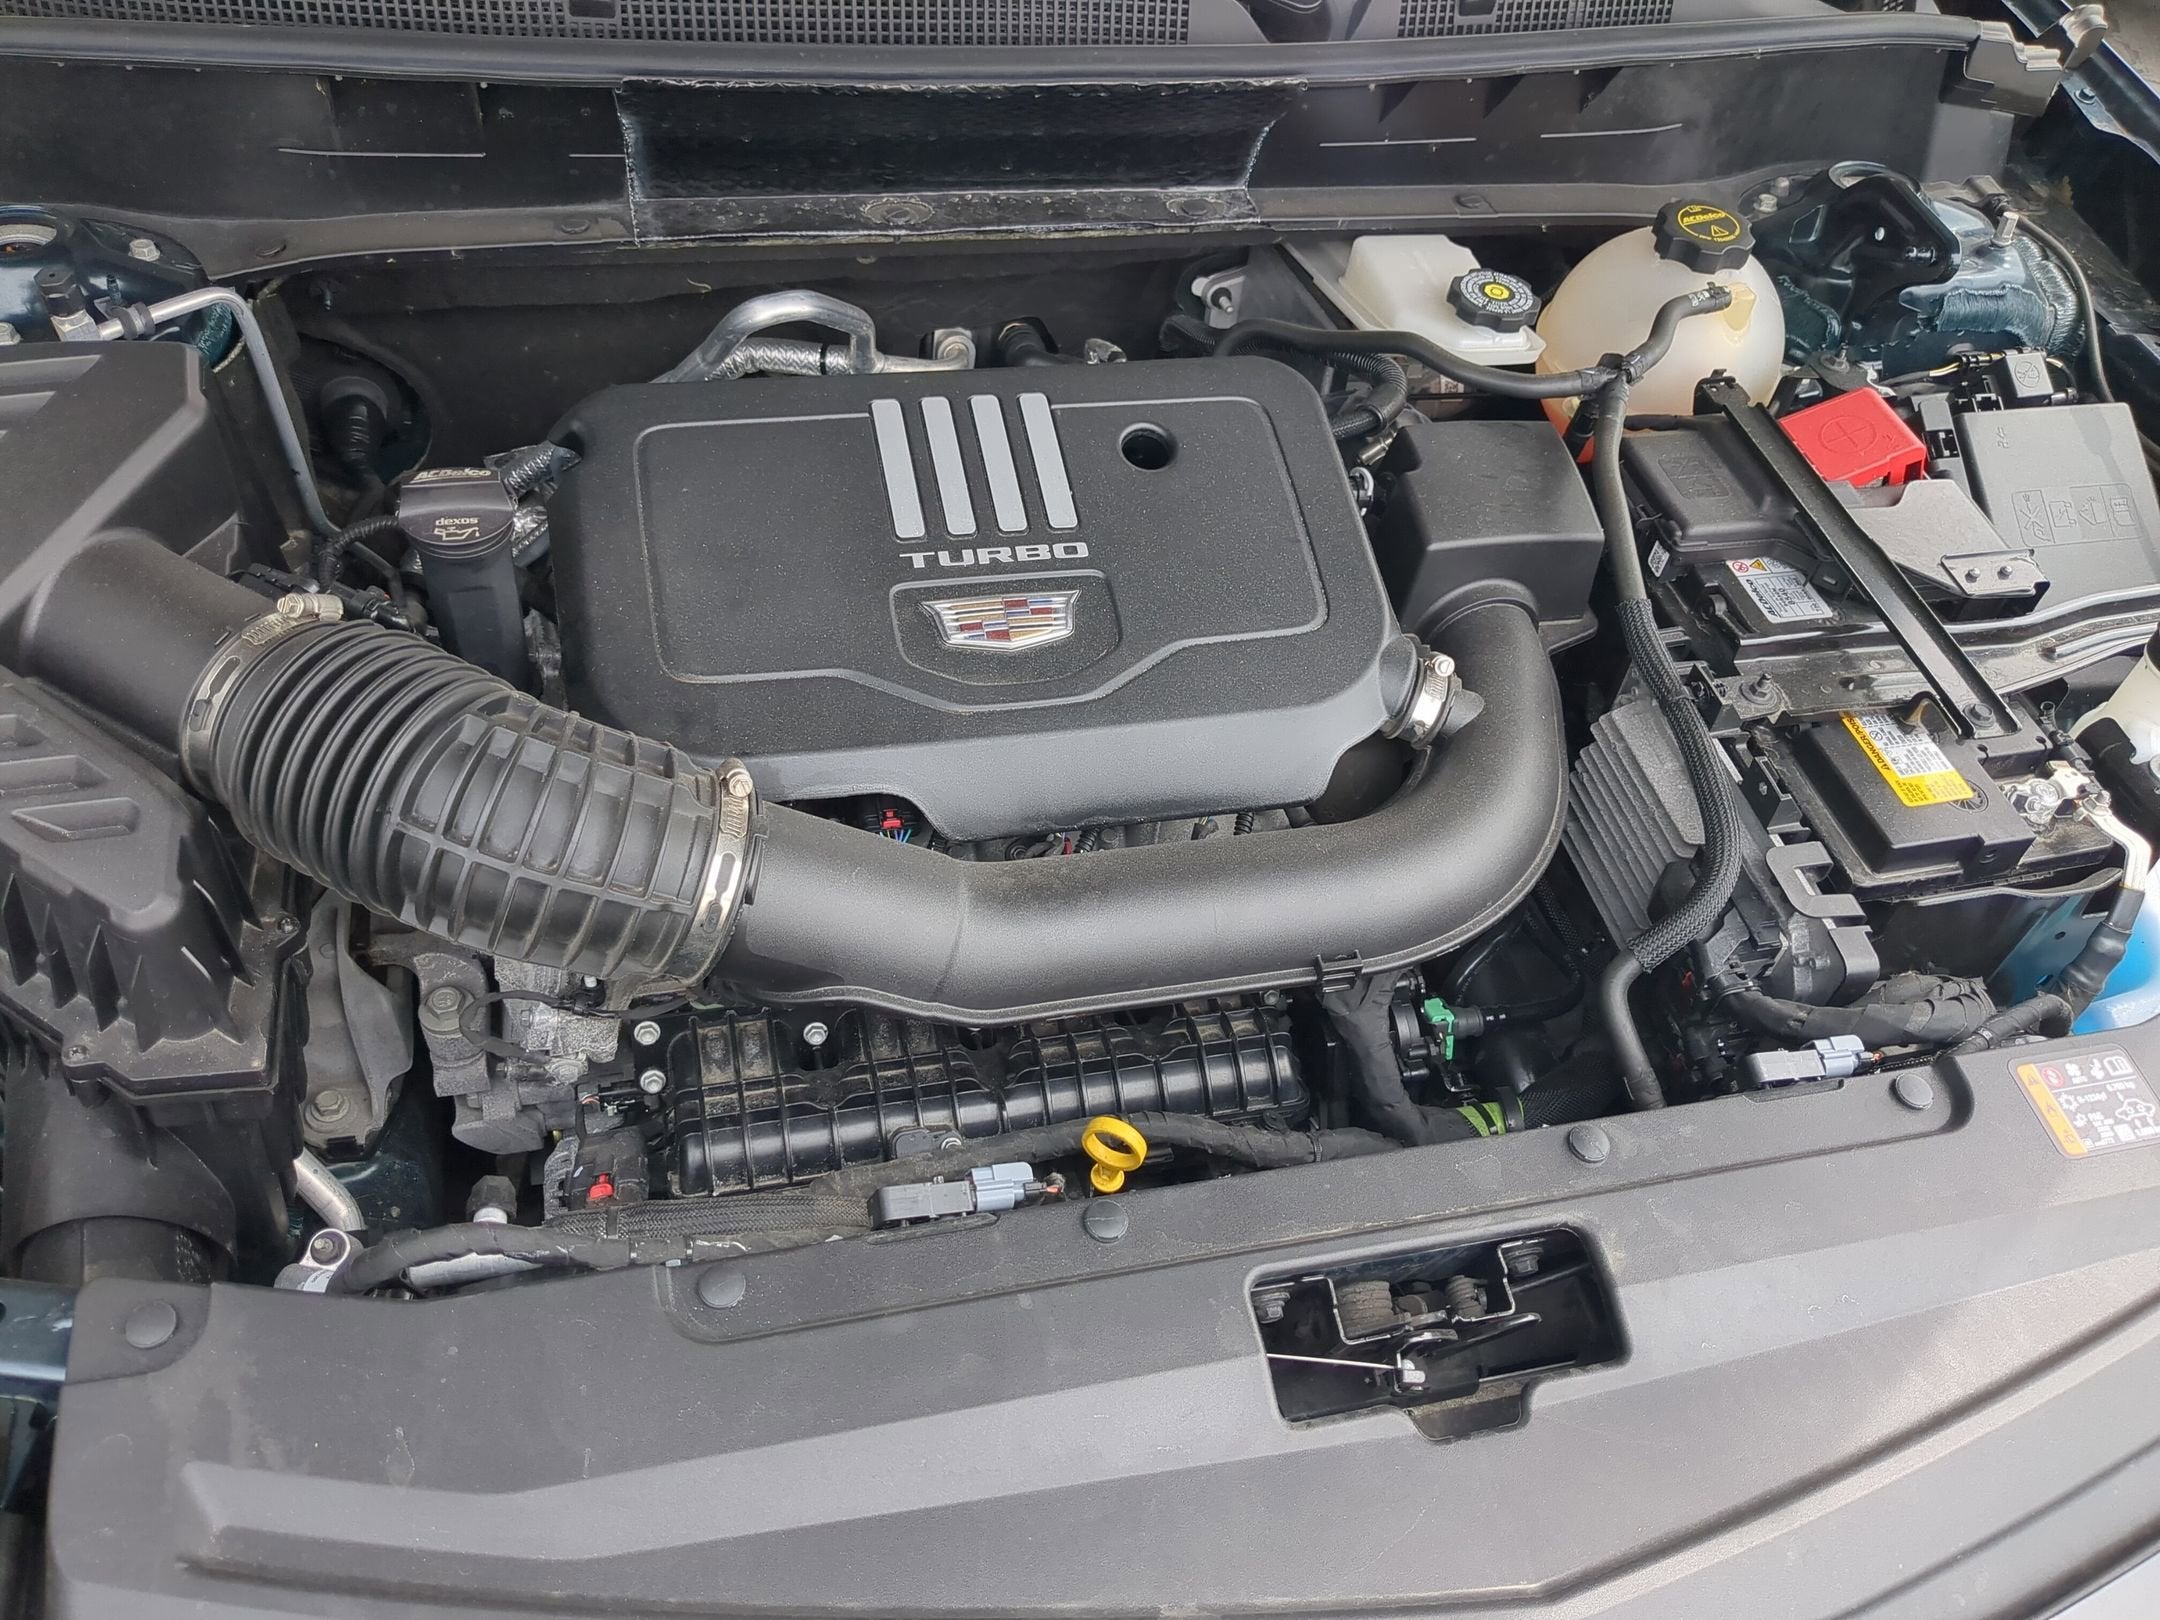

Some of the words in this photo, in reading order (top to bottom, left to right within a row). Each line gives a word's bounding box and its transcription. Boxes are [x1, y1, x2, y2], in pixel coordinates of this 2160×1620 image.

[1682, 212, 1726, 224] ACDelco
[411, 467, 492, 482] ACDelco
[435, 517, 479, 526] dexos
[899, 542, 1090, 569] TURBO
[1745, 578, 1778, 617] ACDelco
